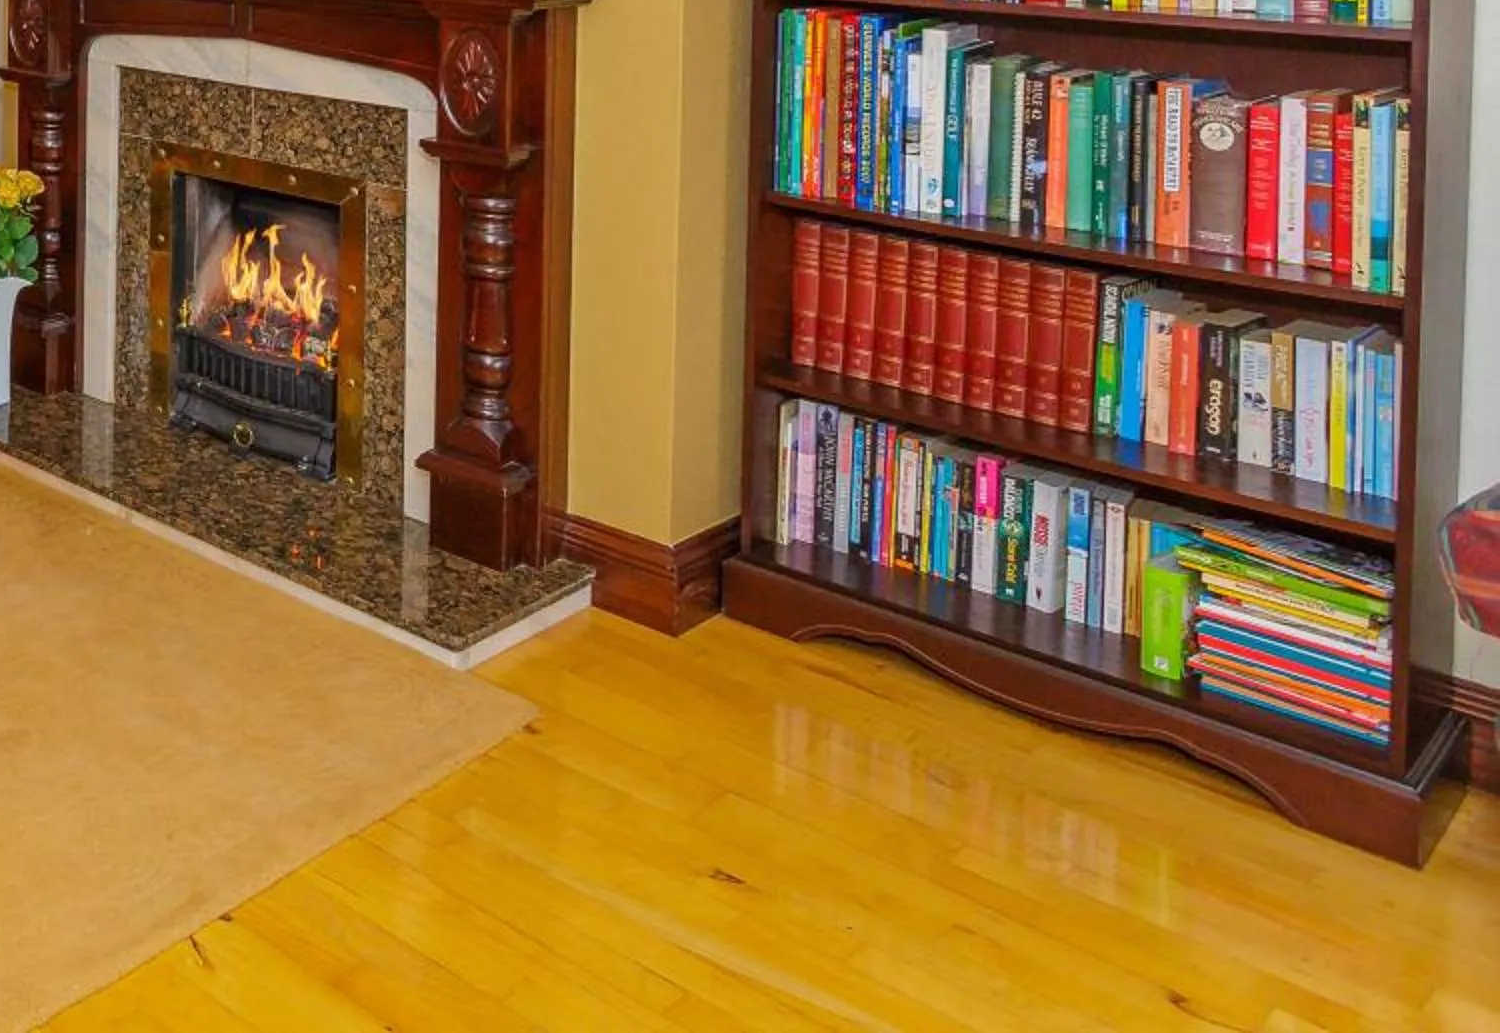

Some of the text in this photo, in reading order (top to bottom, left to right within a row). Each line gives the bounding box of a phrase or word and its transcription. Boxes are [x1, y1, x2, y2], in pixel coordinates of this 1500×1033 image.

[862, 22, 873, 72] GUINNESS
[862, 75, 872, 110] WORLD
[1204, 379, 1223, 436] eragon
